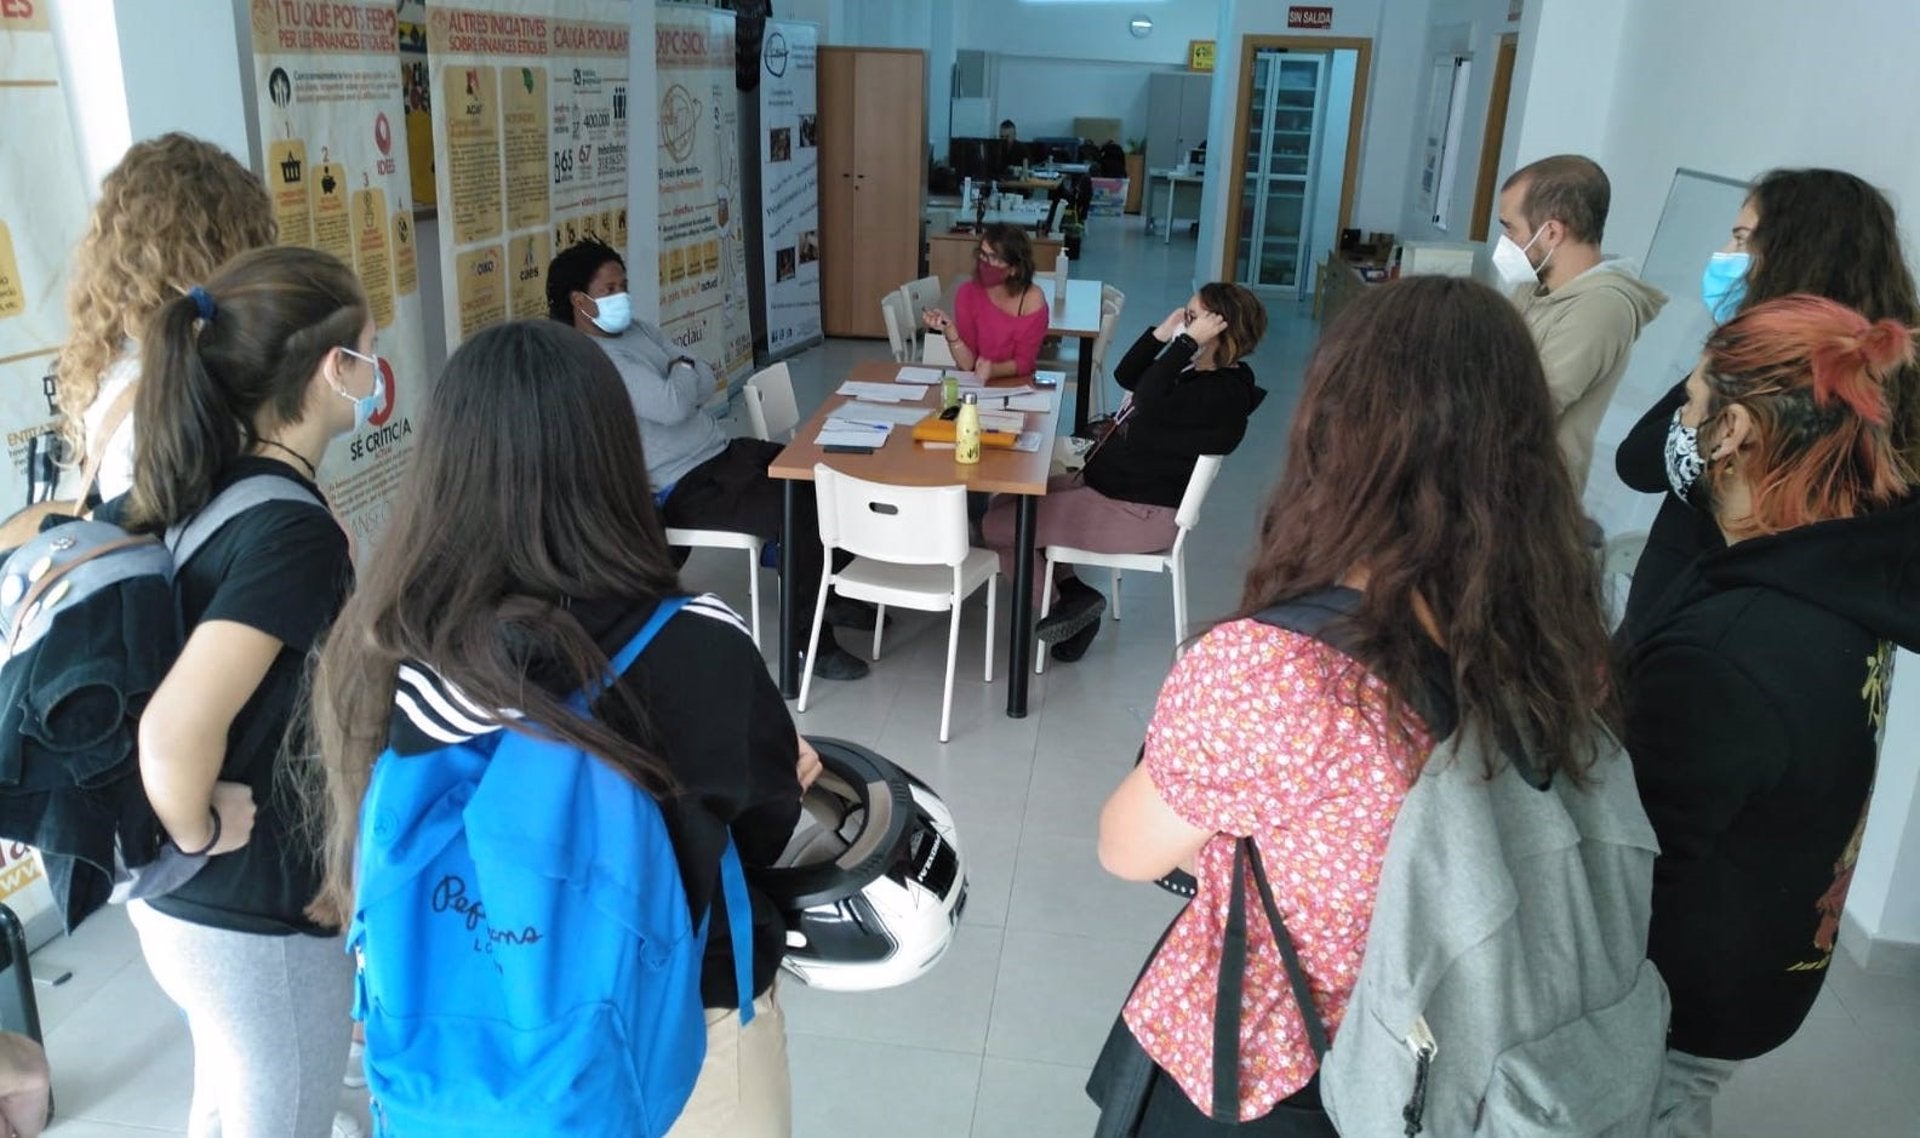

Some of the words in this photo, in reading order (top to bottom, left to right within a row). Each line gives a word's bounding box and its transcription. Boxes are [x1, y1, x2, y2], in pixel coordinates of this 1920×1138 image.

[449, 12, 488, 34] ALTRES
[491, 14, 546, 38] INICIATIVES
[1290, 10, 1302, 23] SIN
[1303, 11, 1331, 24] SALIDA
[313, 32, 360, 50] FINANCES
[449, 35, 478, 52] SOBRE
[479, 37, 517, 54] FINANCES
[553, 25, 586, 49] CAIXA
